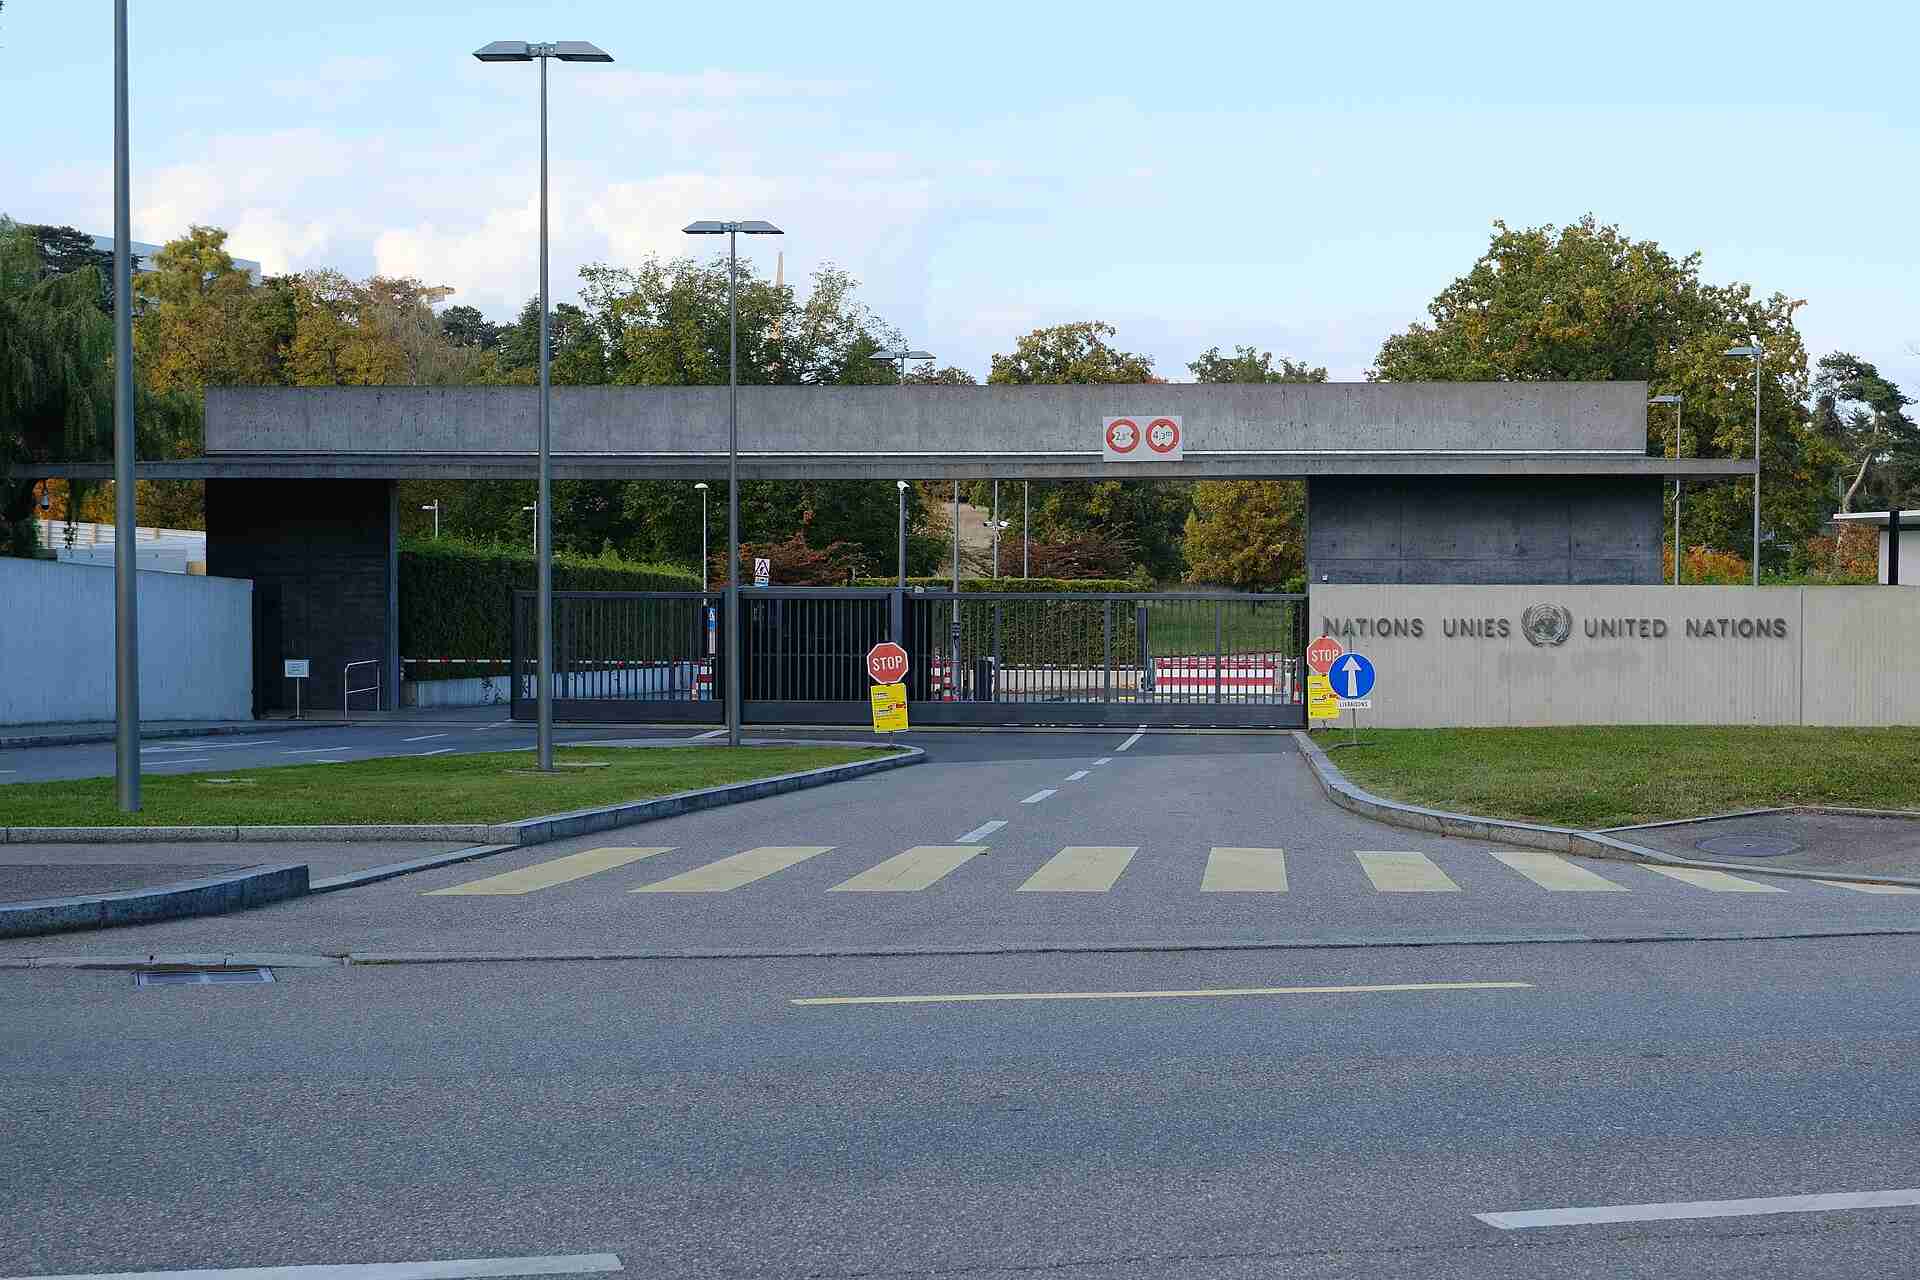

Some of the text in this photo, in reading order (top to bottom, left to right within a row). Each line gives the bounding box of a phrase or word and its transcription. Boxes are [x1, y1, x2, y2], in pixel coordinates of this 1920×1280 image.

[1324, 617, 1511, 637] NATIONS UNIES
[1584, 618, 1787, 638] UNITED NATIONS
[872, 655, 903, 672] STOP
[1312, 649, 1339, 662] STOP
